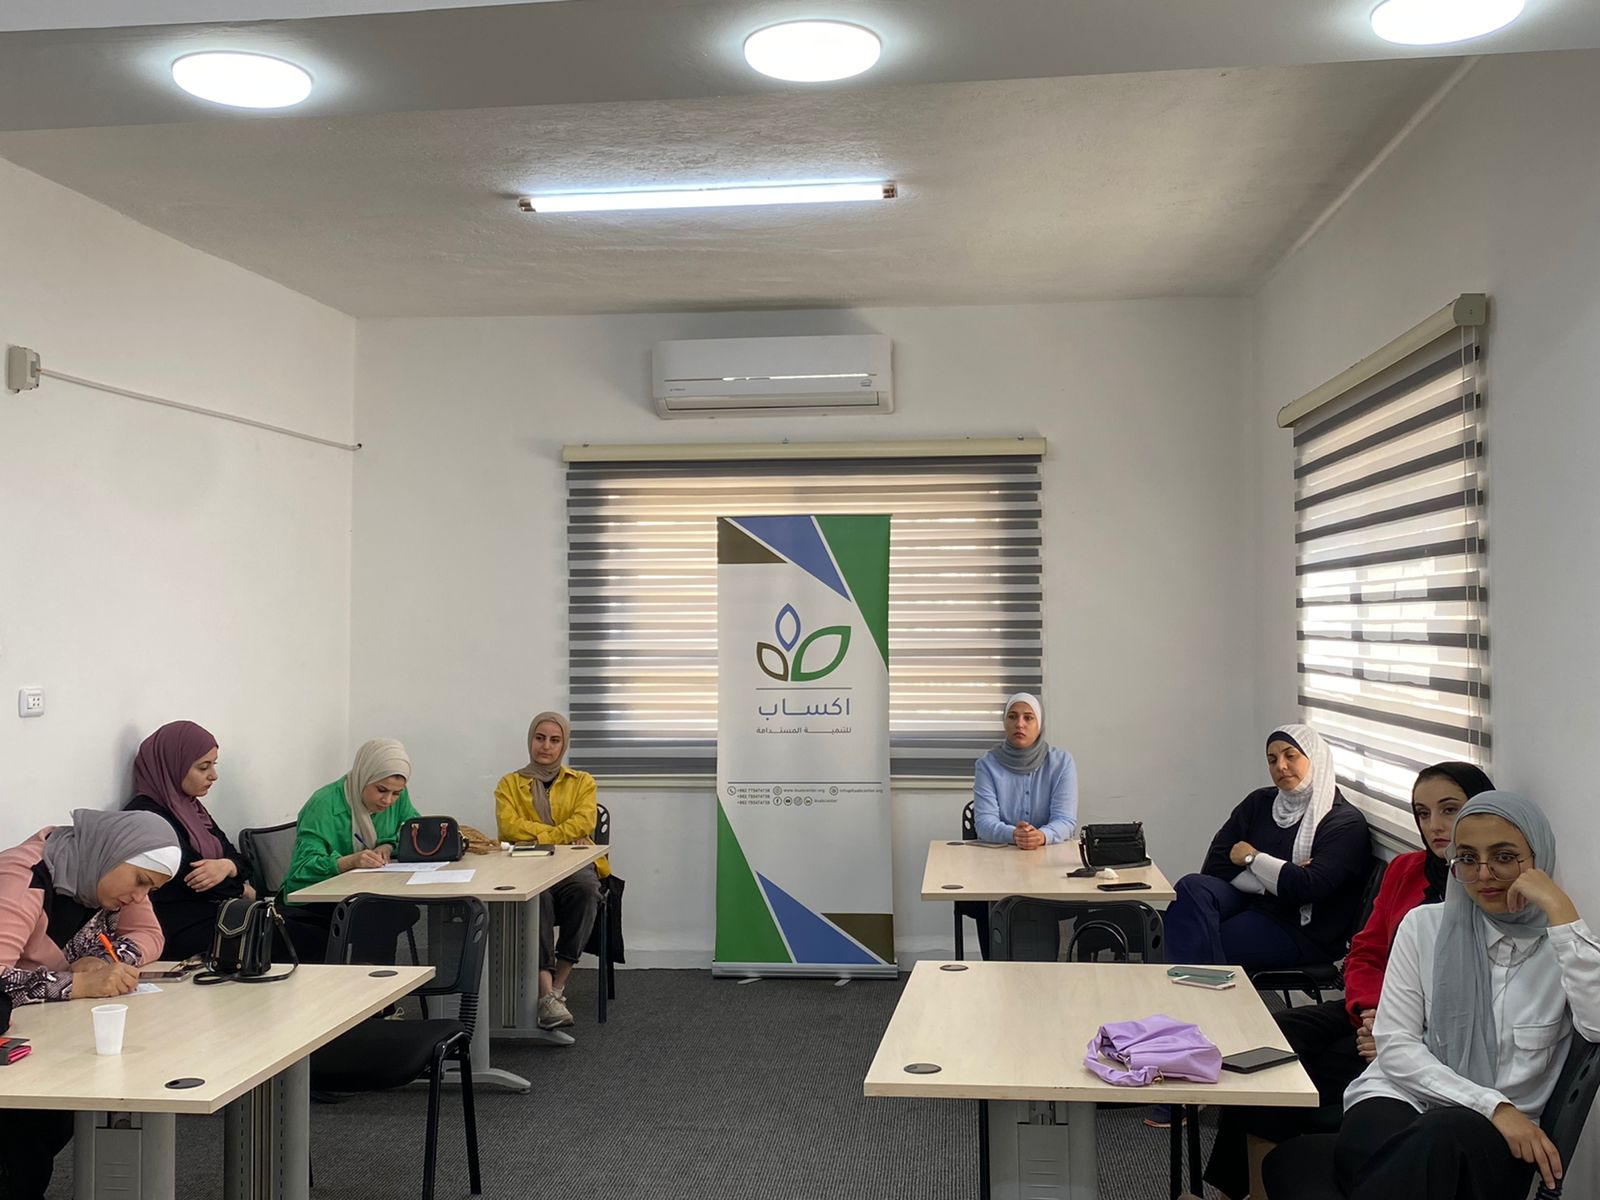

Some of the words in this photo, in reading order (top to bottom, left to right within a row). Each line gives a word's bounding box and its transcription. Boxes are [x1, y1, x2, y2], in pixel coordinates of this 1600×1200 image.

[758, 697, 850, 721] اكساب
[756, 726, 802, 734] المستدامة
[804, 726, 852, 735] للتنمية
